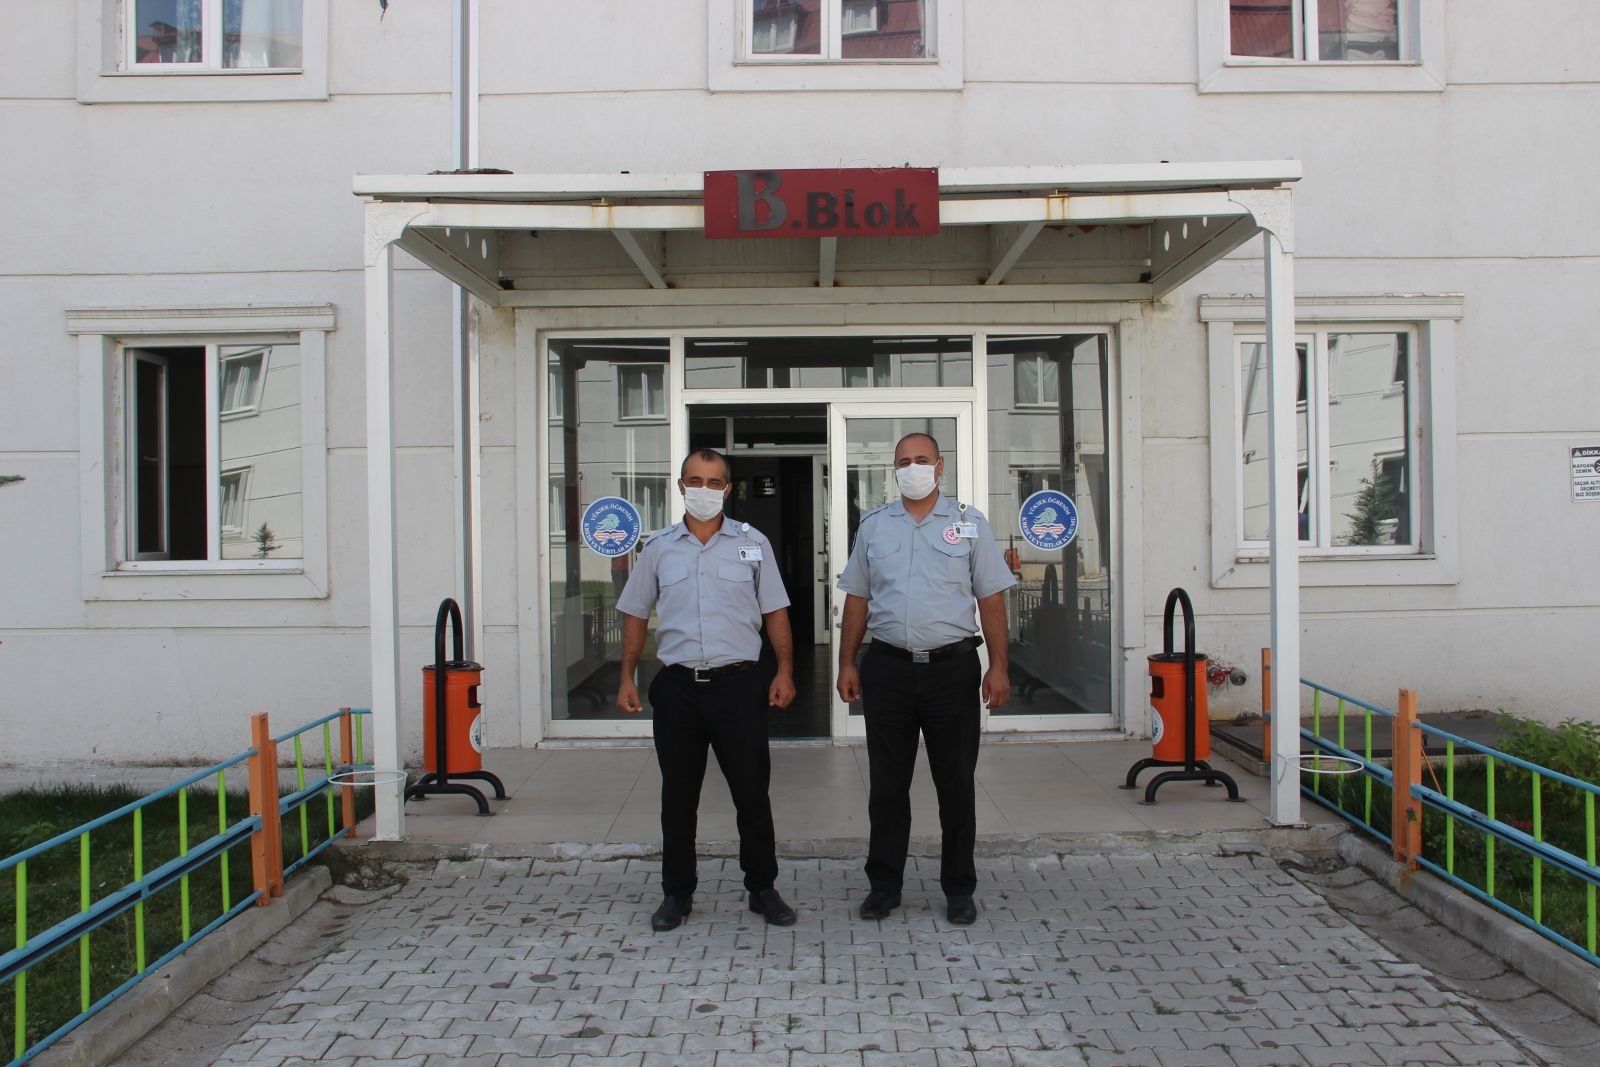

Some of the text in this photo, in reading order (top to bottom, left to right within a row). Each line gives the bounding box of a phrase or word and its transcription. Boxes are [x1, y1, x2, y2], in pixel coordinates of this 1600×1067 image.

[591, 503, 633, 522] YÜKSEK ÖĞRENİM
[1028, 497, 1071, 515] YÜKSEK ÖĞRENİM
[597, 546, 626, 555] YURTLAR
